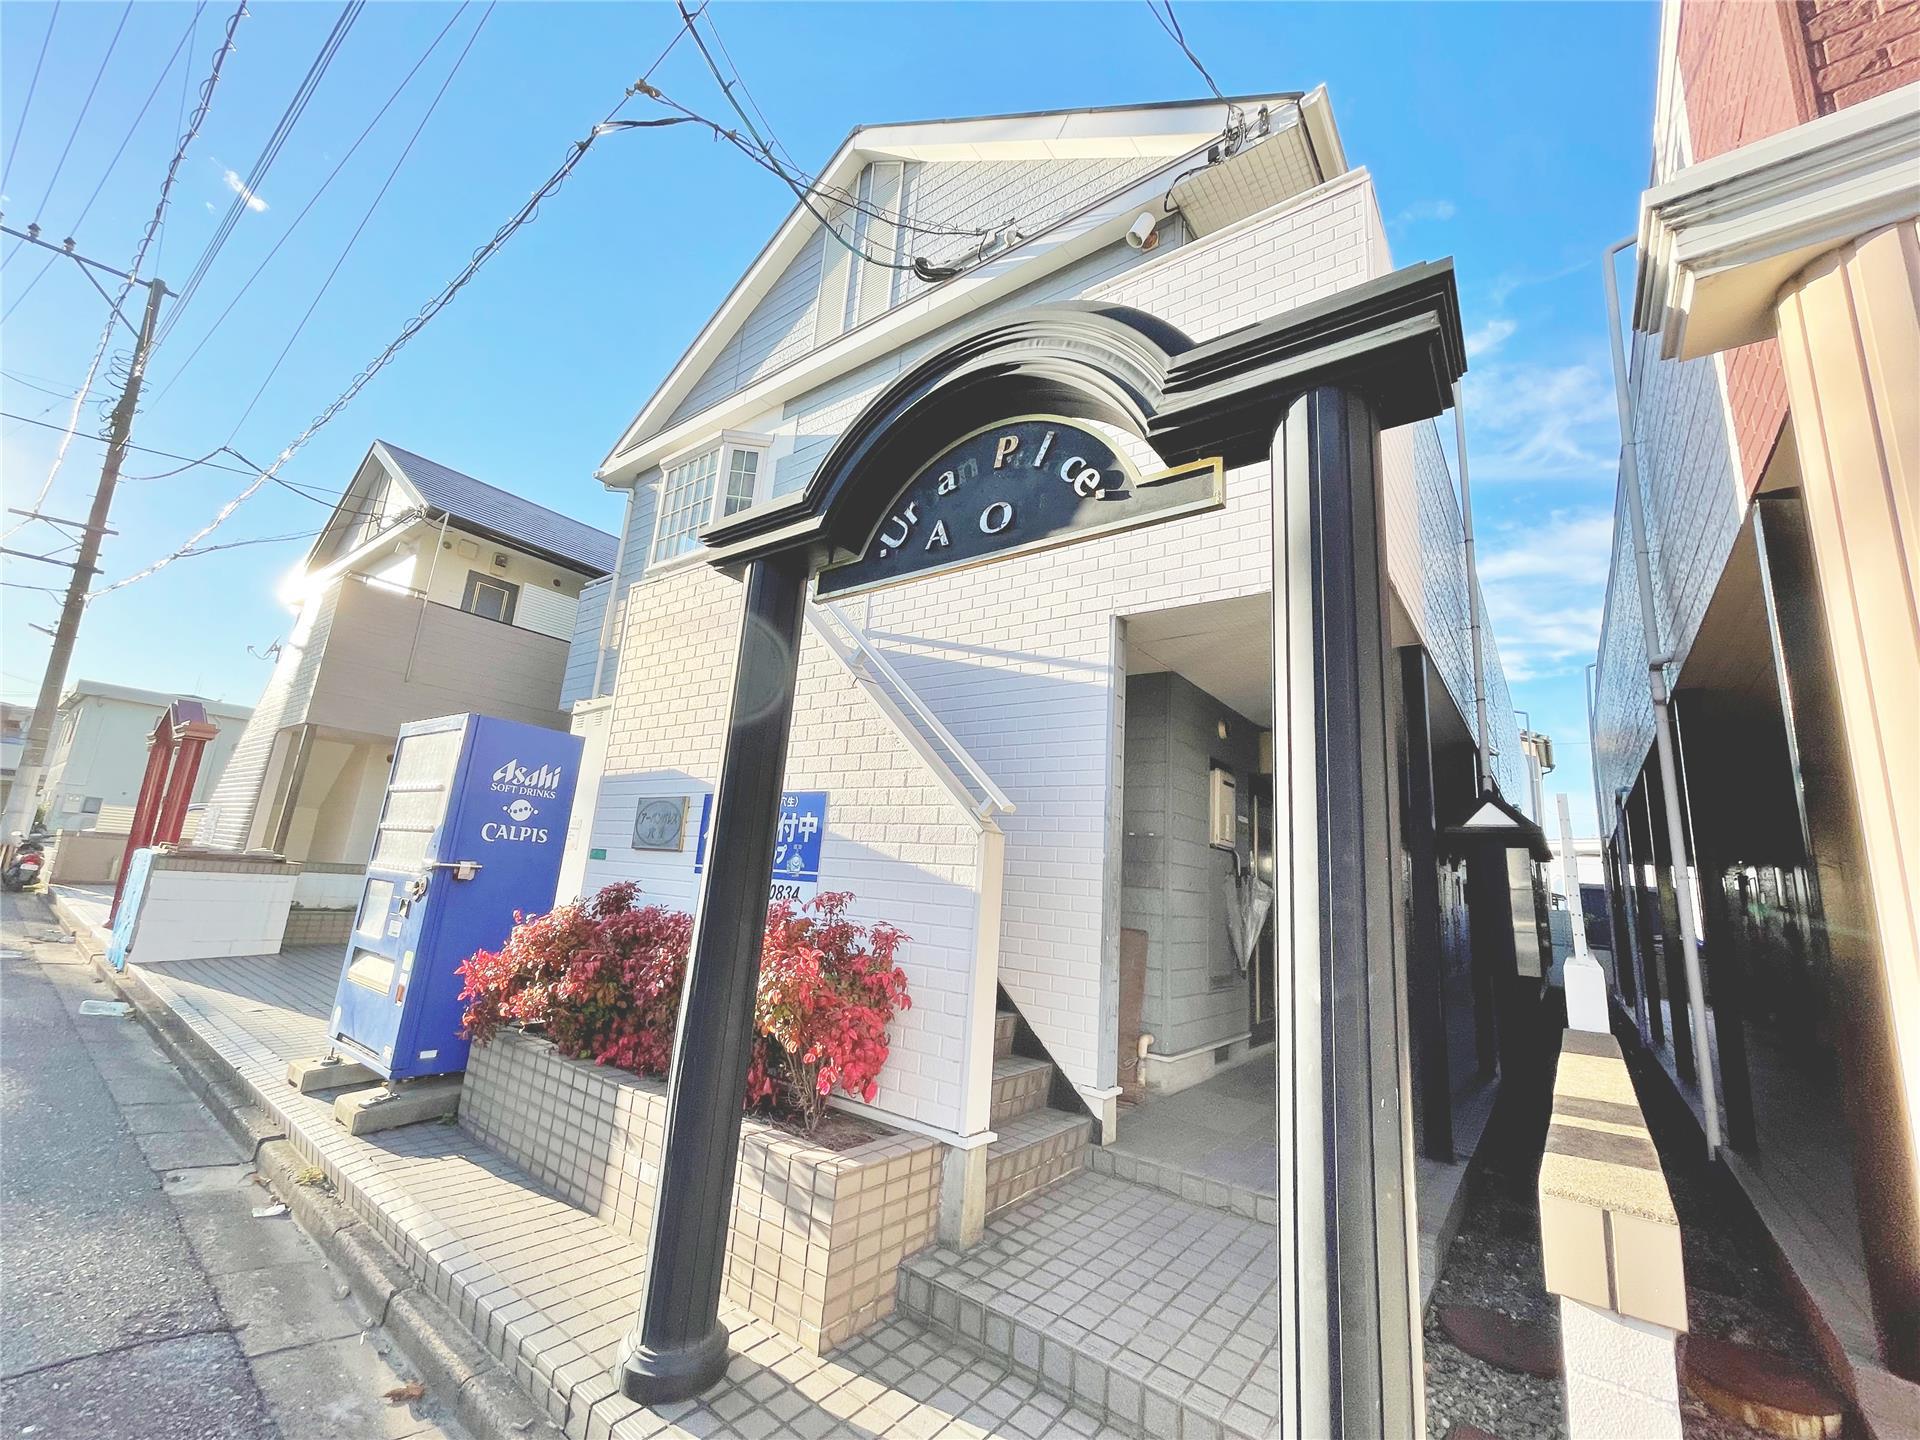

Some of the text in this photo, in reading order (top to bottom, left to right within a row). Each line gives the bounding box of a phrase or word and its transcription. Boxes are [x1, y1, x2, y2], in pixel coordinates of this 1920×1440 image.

[492, 759, 561, 790] Asahi
[490, 782, 556, 799] SOFT DRINKS
[481, 822, 548, 843] CALPIS
[777, 812, 818, 843] 付中
